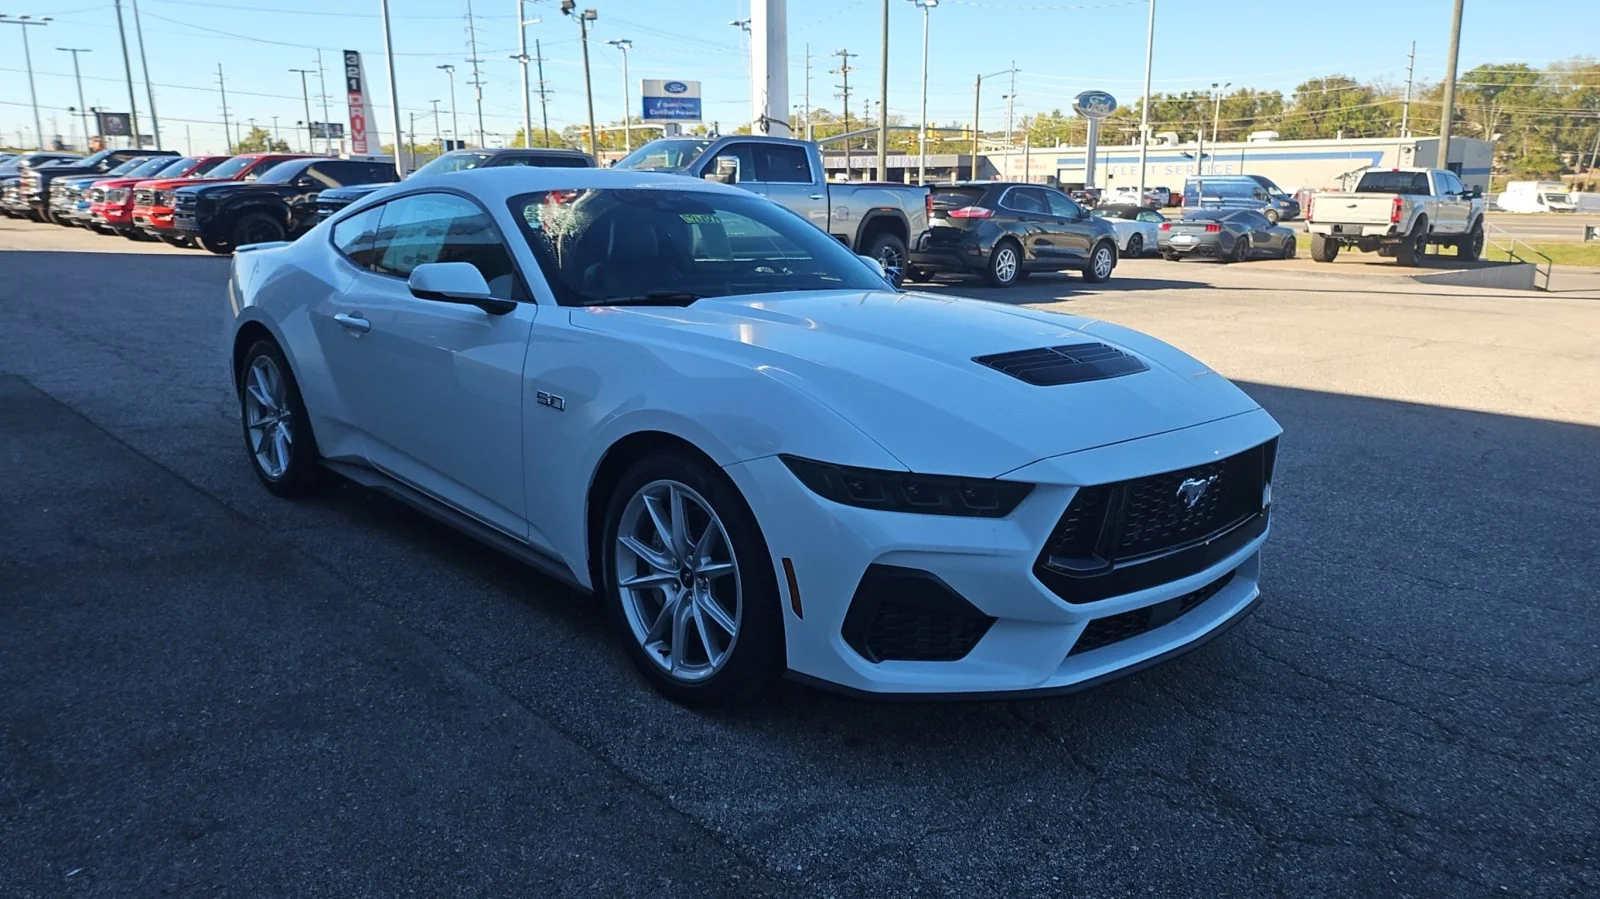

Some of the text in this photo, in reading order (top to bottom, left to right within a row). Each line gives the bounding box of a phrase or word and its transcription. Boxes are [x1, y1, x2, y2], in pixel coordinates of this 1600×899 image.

[345, 54, 366, 153] 321 DRIVE
[1112, 163, 1233, 176] FLET SERICE
